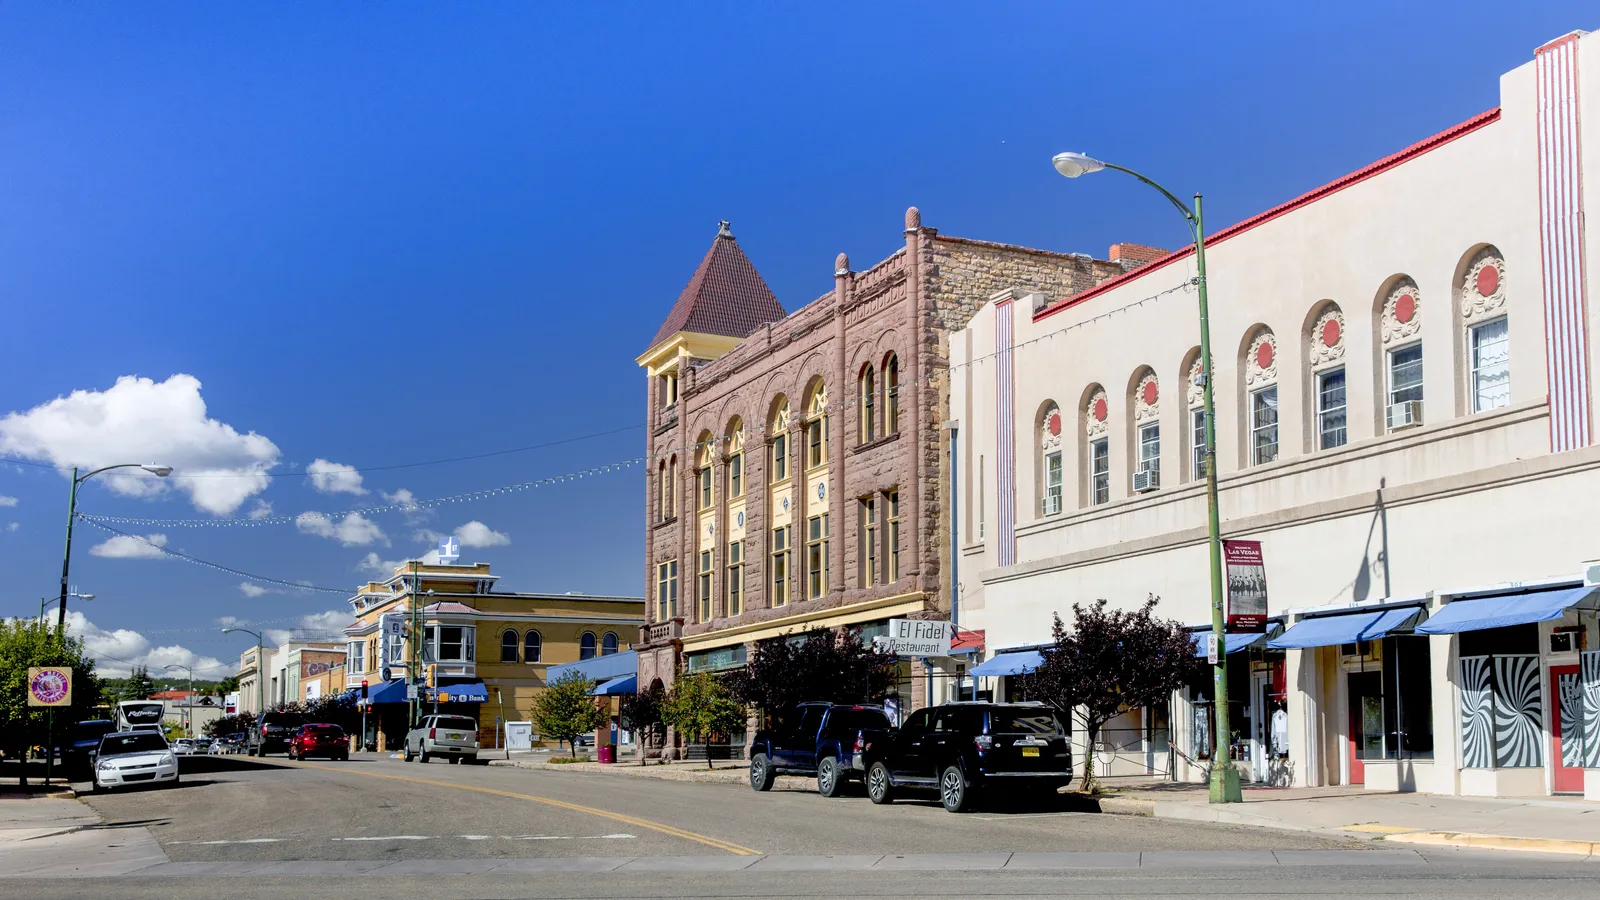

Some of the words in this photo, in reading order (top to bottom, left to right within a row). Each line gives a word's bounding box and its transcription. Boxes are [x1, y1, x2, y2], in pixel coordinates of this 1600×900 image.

[900, 621, 911, 639] El
[915, 622, 945, 639] Fidel
[888, 639, 940, 653] Restaurant
